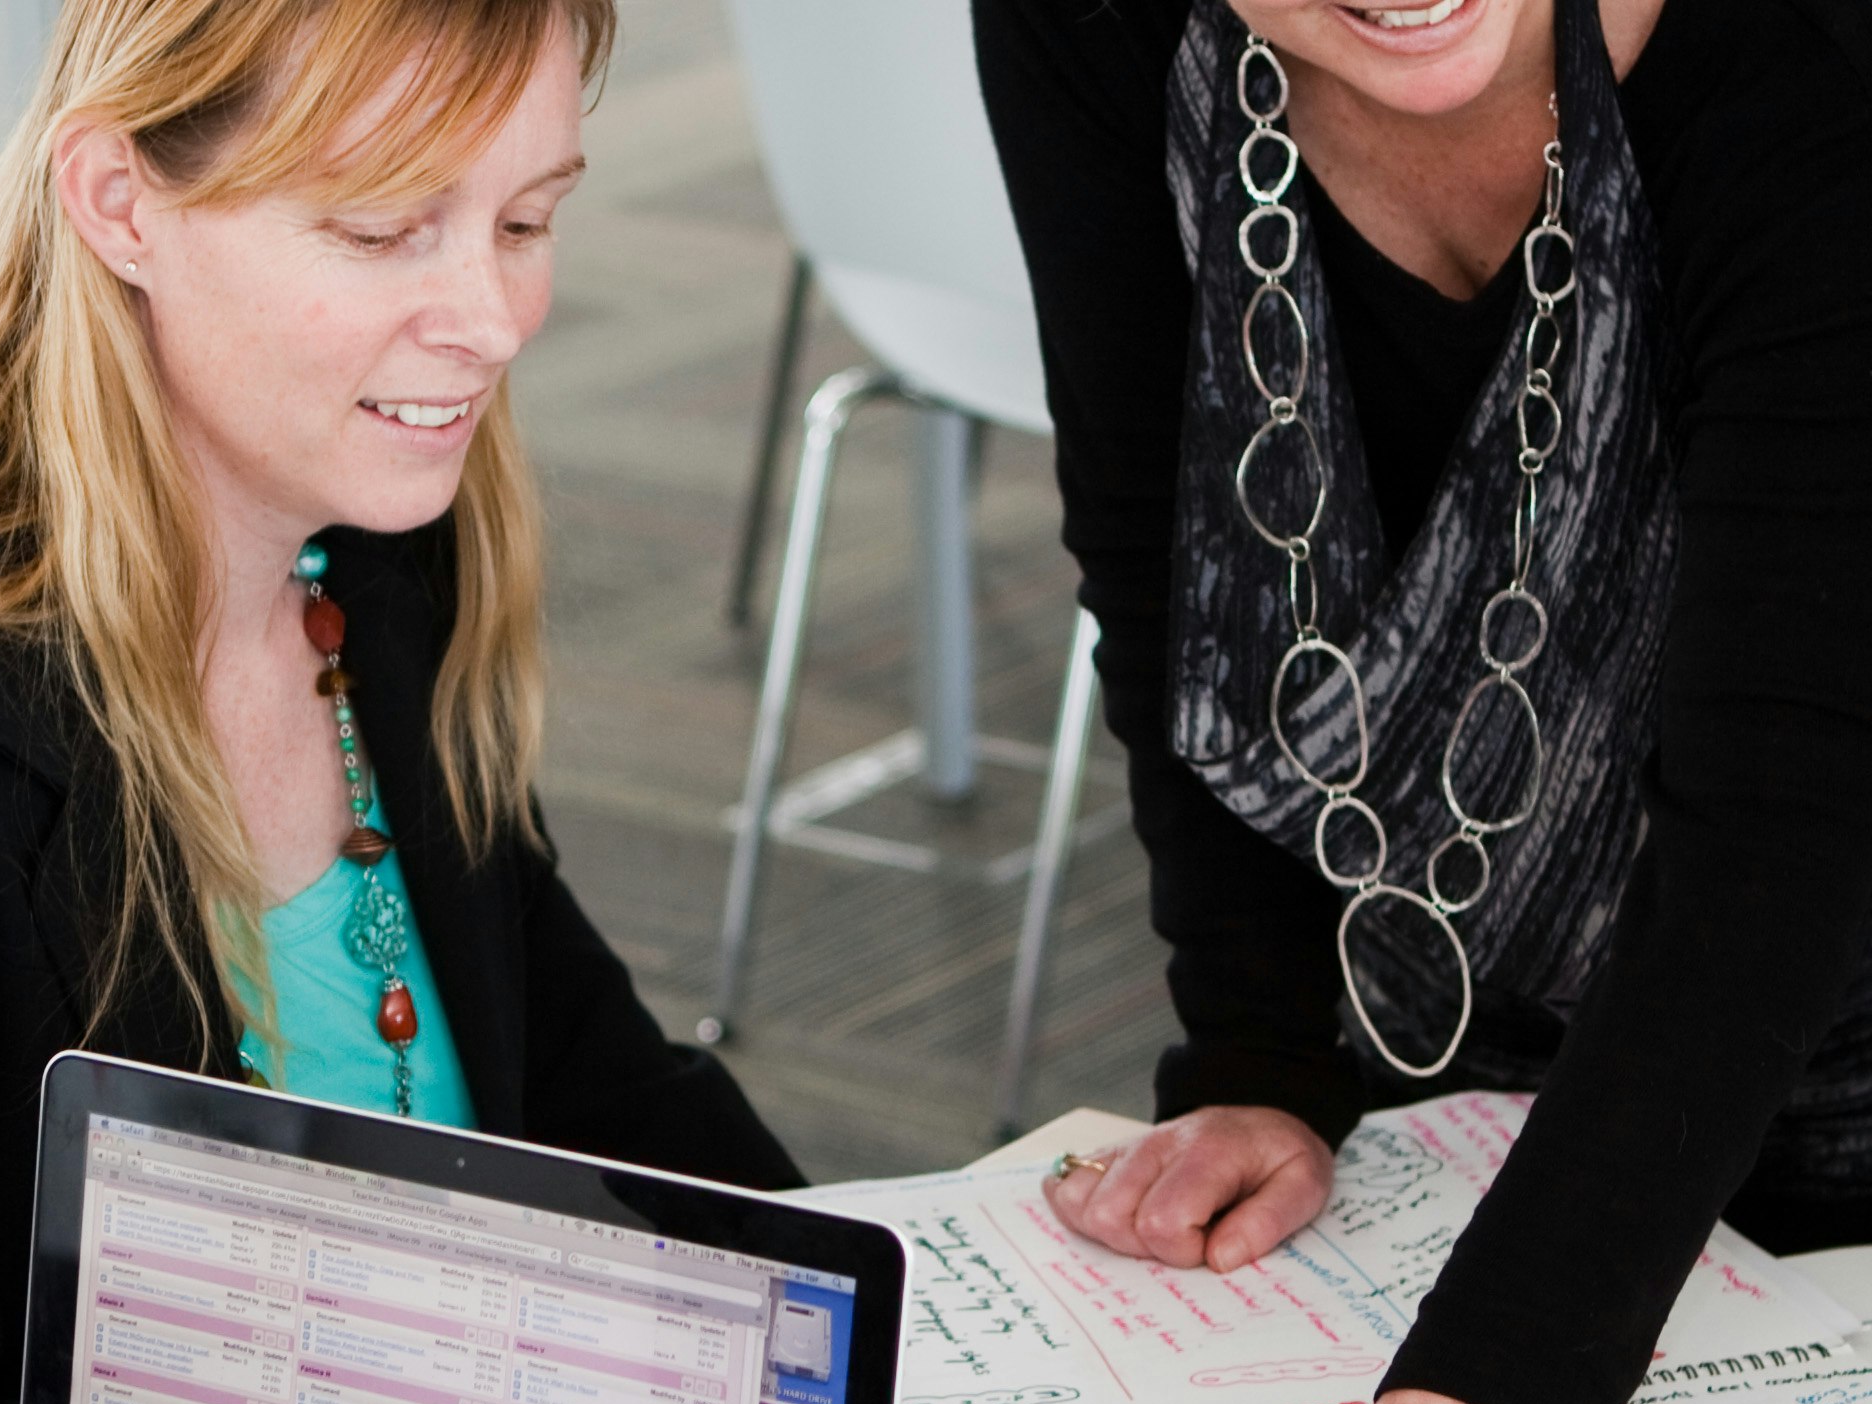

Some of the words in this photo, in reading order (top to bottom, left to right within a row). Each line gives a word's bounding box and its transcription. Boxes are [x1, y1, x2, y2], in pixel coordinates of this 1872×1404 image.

[120, 1124, 145, 1136] Safari
[154, 1131, 168, 1142] File
[178, 1135, 193, 1146] Edit
[203, 1141, 223, 1153] View
[270, 1156, 315, 1174] Bookmarks
[325, 1168, 358, 1182] Window
[366, 1176, 386, 1189] Help
[383, 1197, 424, 1215] Dashboard
[426, 1206, 437, 1216] for
[439, 1209, 466, 1224] Google
[468, 1213, 488, 1227] Apps
[672, 1243, 689, 1255] Tue
[712, 1252, 726, 1263] PM
[736, 1256, 753, 1270] The
